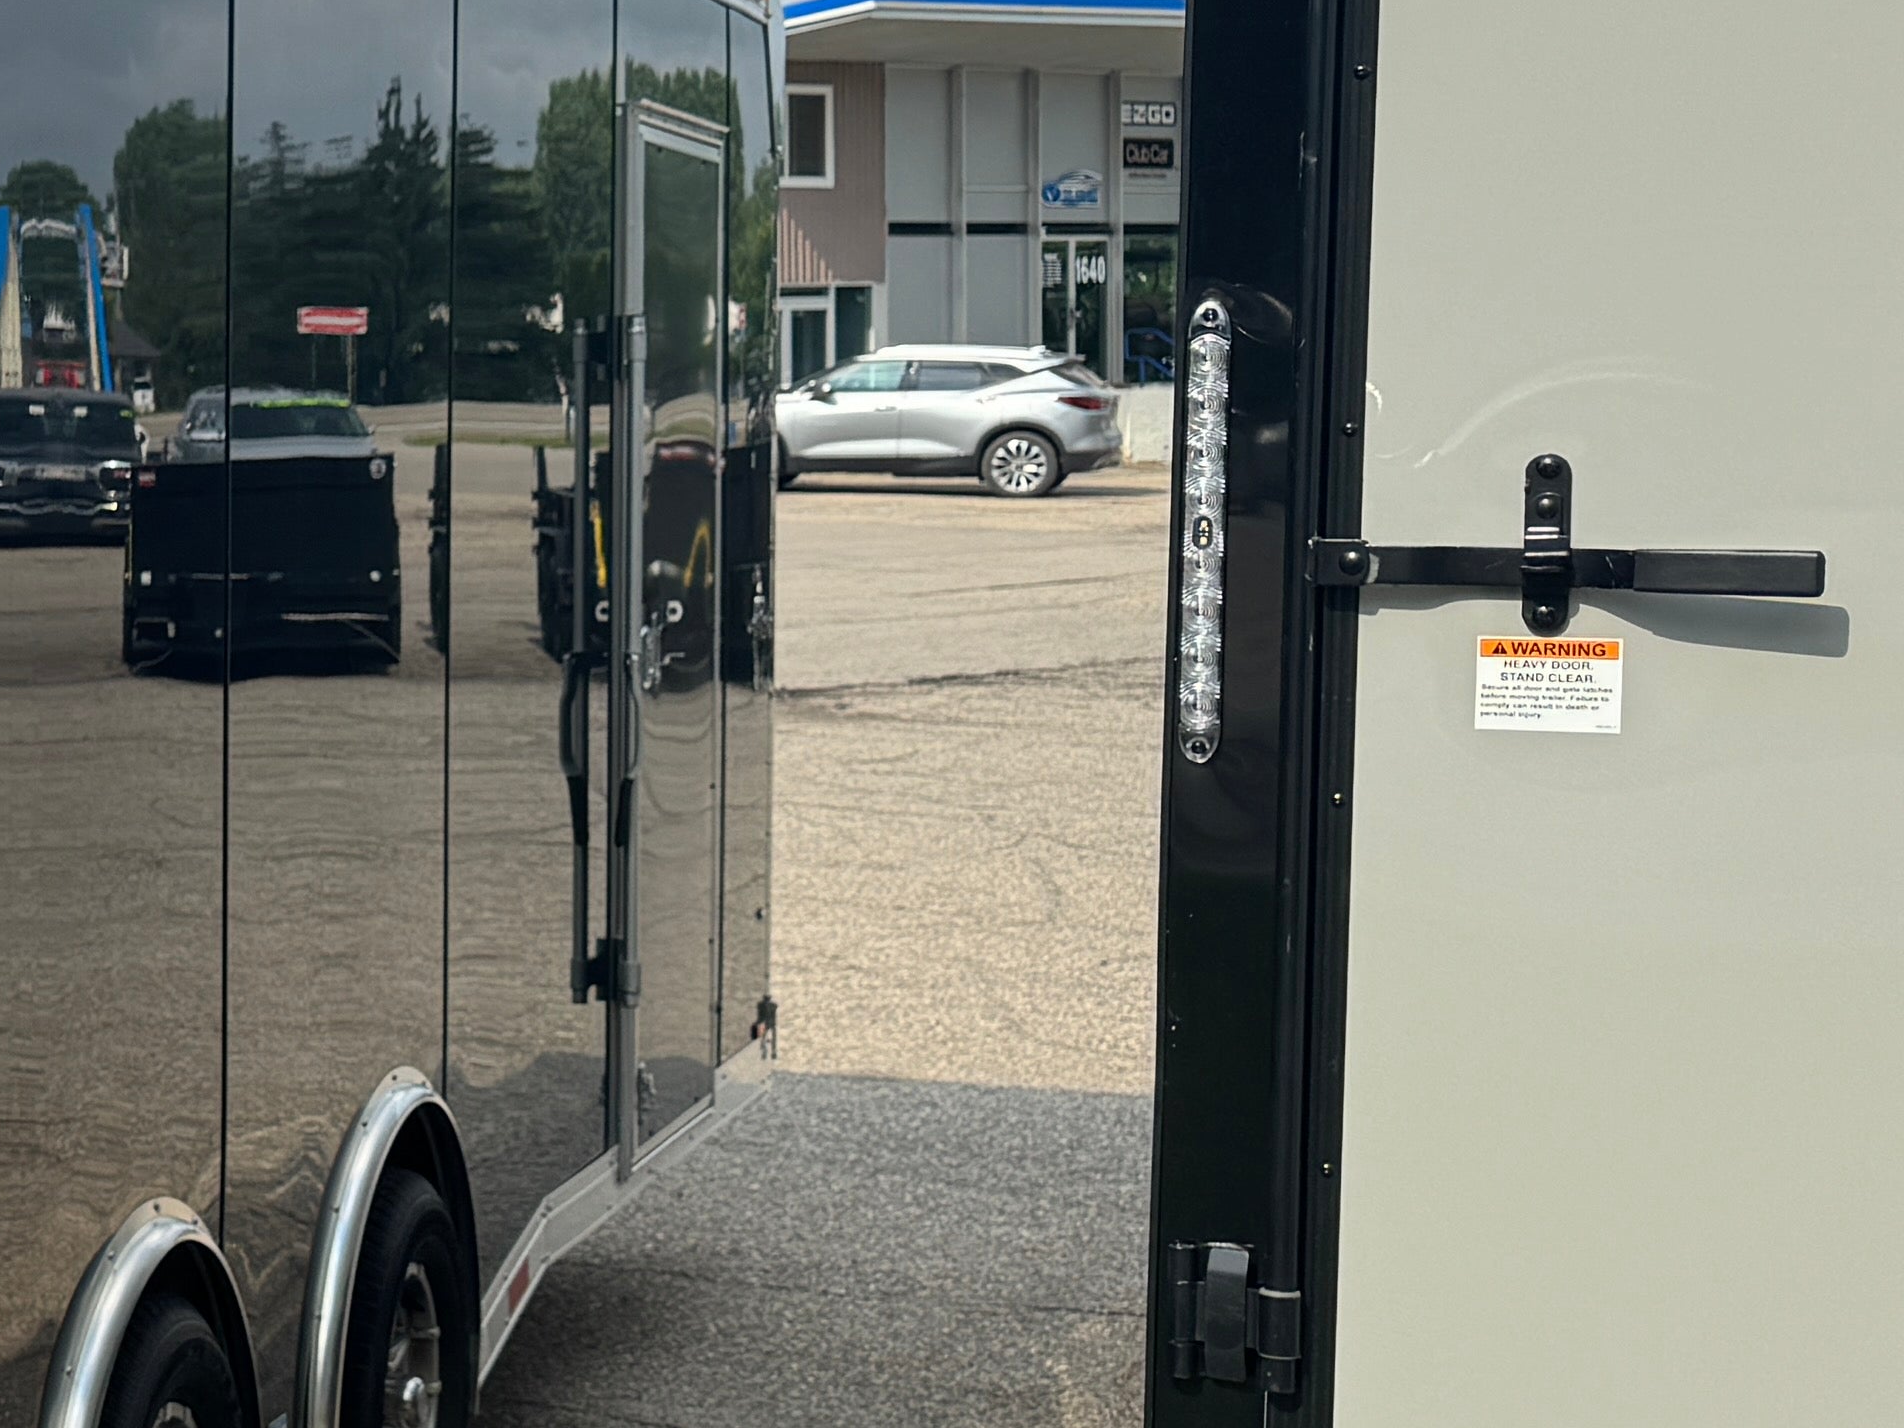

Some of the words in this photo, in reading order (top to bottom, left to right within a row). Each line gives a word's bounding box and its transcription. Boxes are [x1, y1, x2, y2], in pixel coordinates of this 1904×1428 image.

[1076, 255, 1106, 284] 1640
[1511, 642, 1607, 657] WARNING
[1504, 660, 1547, 669] HEAVY
[1552, 661, 1594, 670] DOOR.
[1500, 672, 1544, 682] STAND
